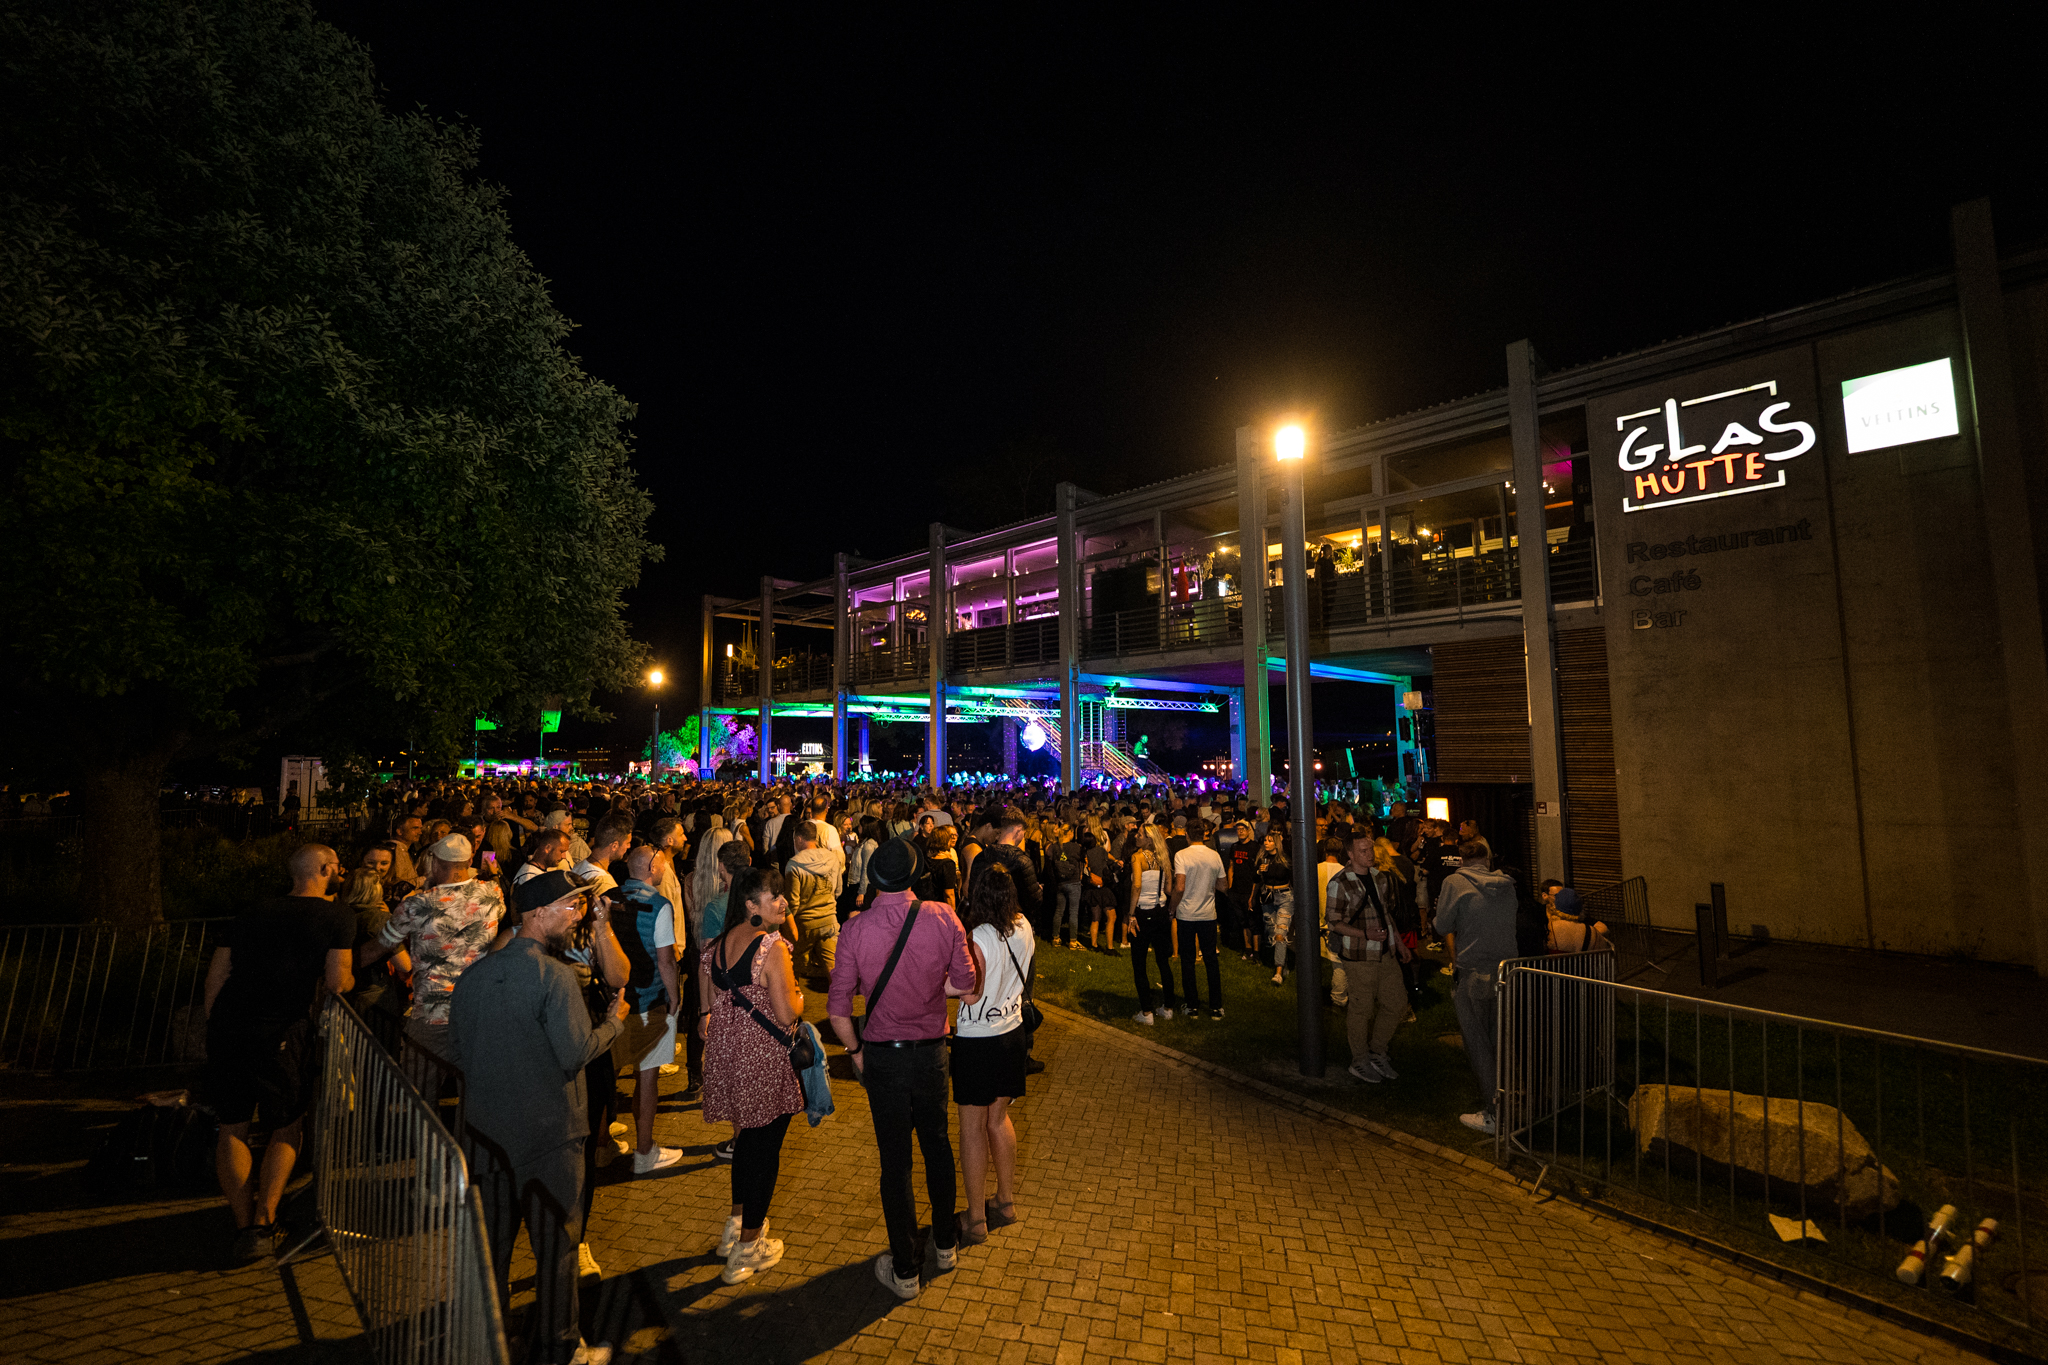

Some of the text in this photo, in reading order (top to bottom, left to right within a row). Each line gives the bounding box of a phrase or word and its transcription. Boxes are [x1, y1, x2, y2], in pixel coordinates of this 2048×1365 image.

[1618, 398, 1816, 471] GLAS
[1635, 452, 1765, 499] HÜTTE
[1626, 518, 1813, 563] Restaurant
[1630, 568, 1701, 596] Café
[1632, 609, 1687, 630] Bar
